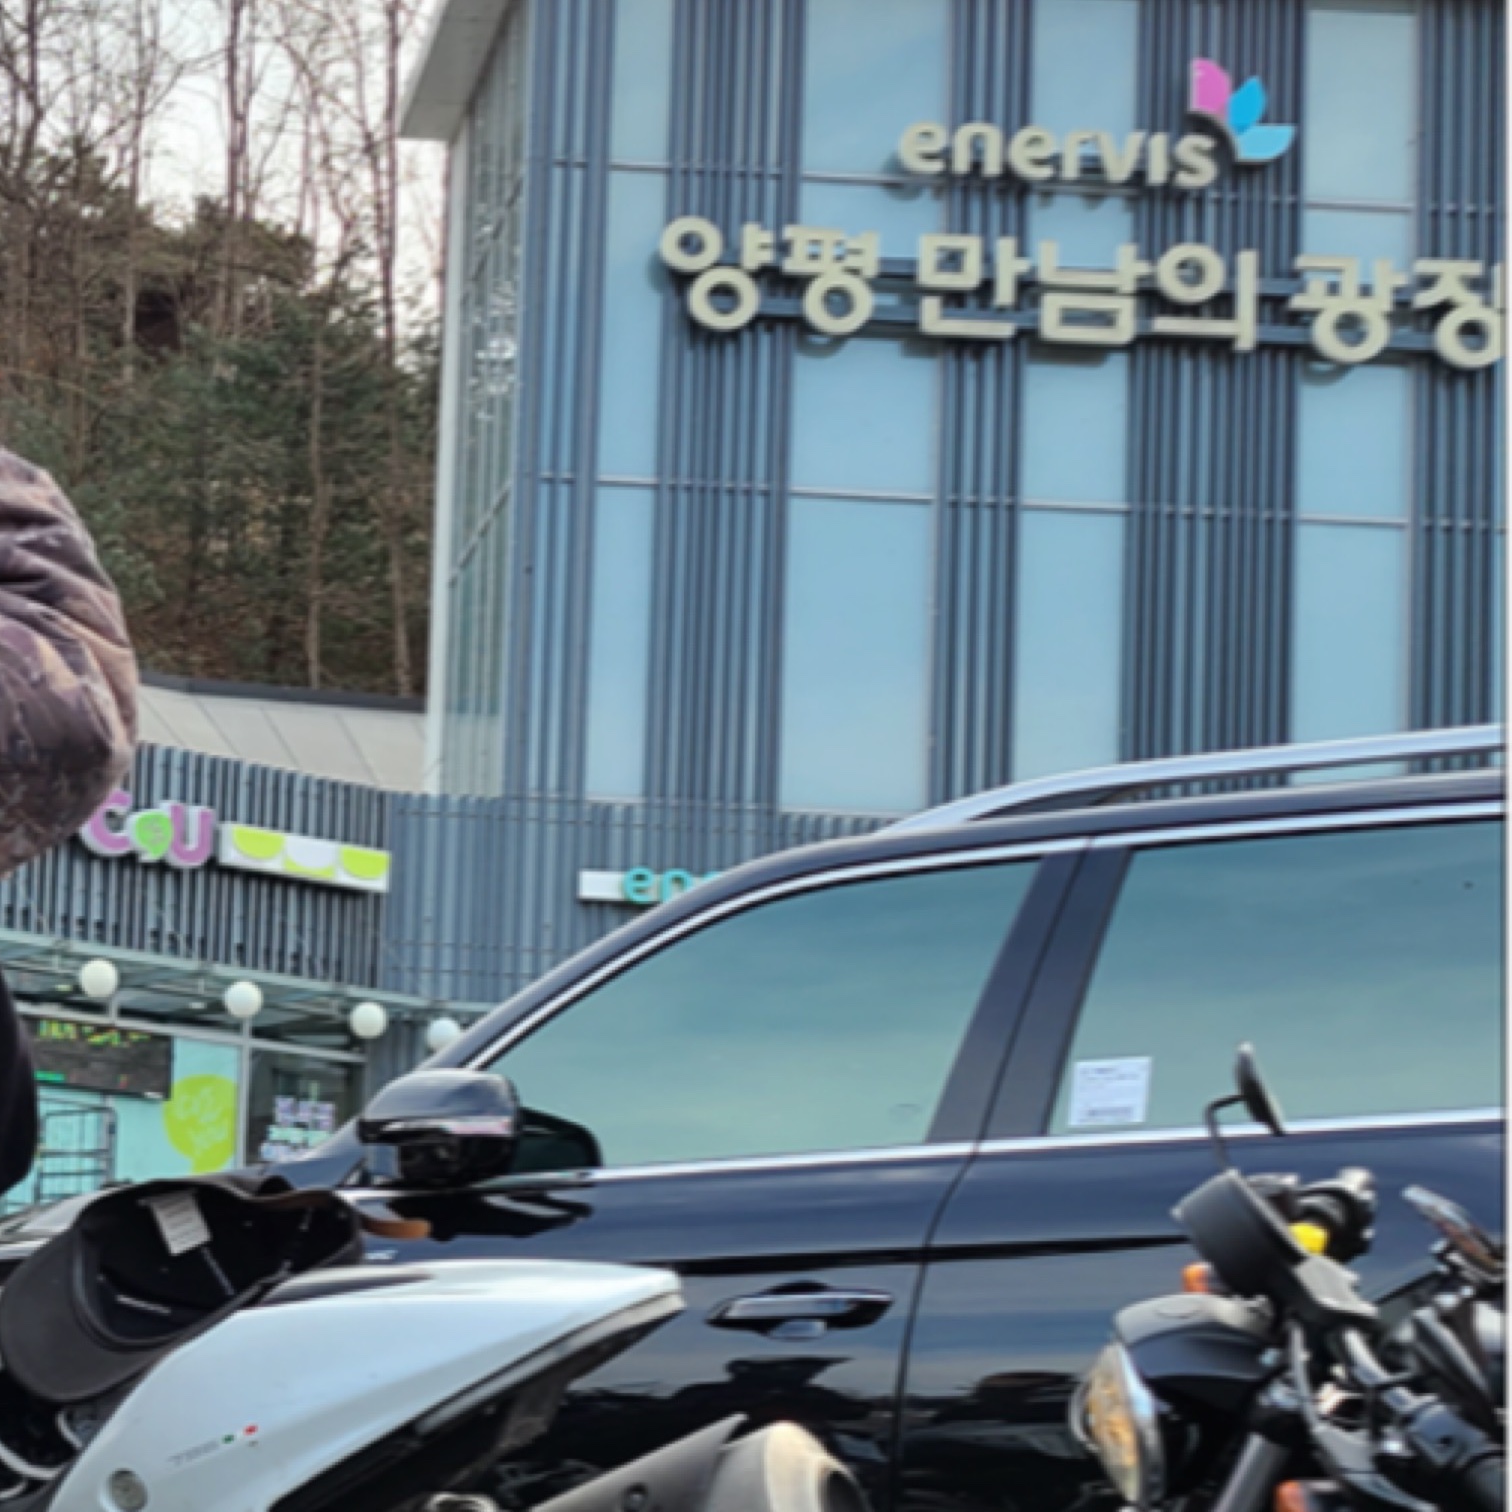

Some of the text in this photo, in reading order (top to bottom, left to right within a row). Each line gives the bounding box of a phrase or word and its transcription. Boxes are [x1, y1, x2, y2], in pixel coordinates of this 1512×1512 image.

[899, 121, 1218, 187] enervis
[660, 215, 879, 335] 양평
[916, 233, 1259, 351] 만남의
[622, 866, 721, 905] en
